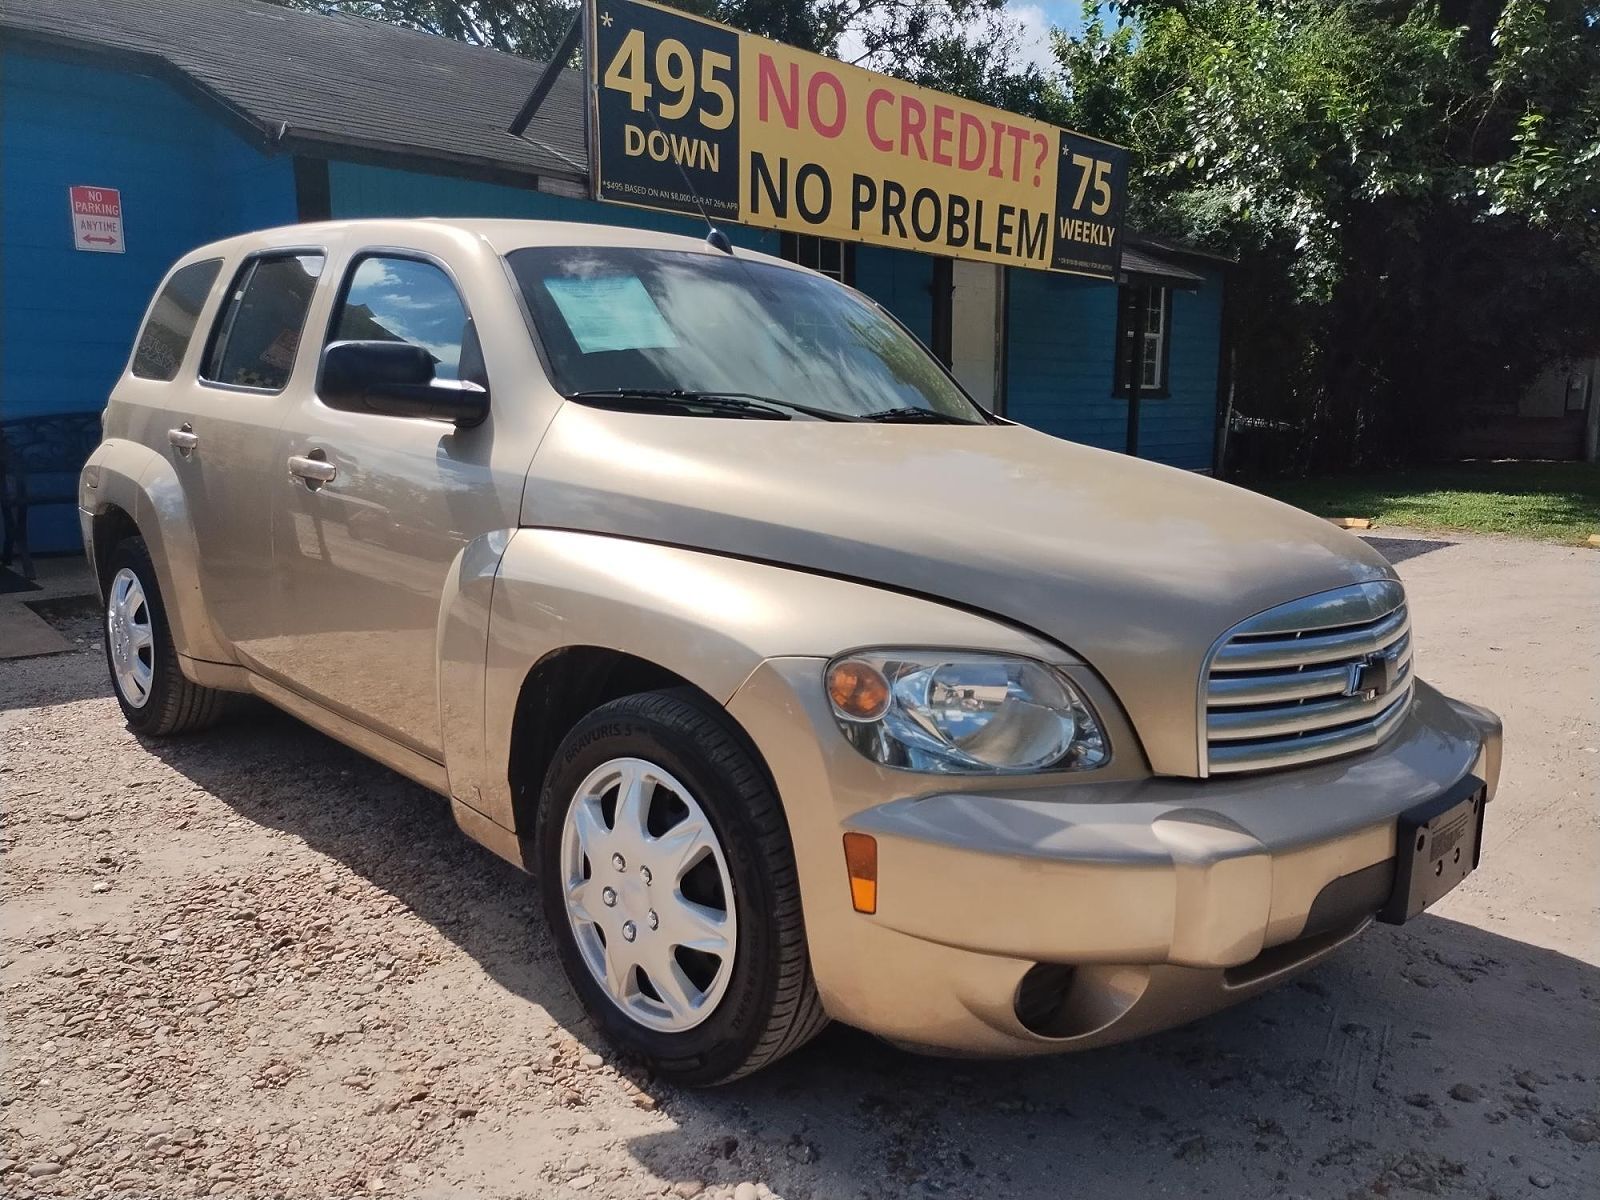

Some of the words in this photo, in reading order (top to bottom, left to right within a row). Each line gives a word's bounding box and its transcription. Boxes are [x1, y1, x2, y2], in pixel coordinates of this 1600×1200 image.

[759, 53, 847, 139] NO
[865, 88, 1050, 188] CREDIT?
[624, 124, 720, 173] DOWN
[88, 190, 103, 202] NO
[624, 183, 647, 195] BASED
[647, 188, 659, 198] ON
[659, 190, 670, 200] AN
[705, 198, 713, 206] AT
[750, 150, 832, 225] NO
[851, 173, 1049, 261] PROBLEM
[75, 201, 119, 216] PARKING
[81, 219, 118, 233] ANYTIME
[1060, 216, 1116, 247] WEEKLY
